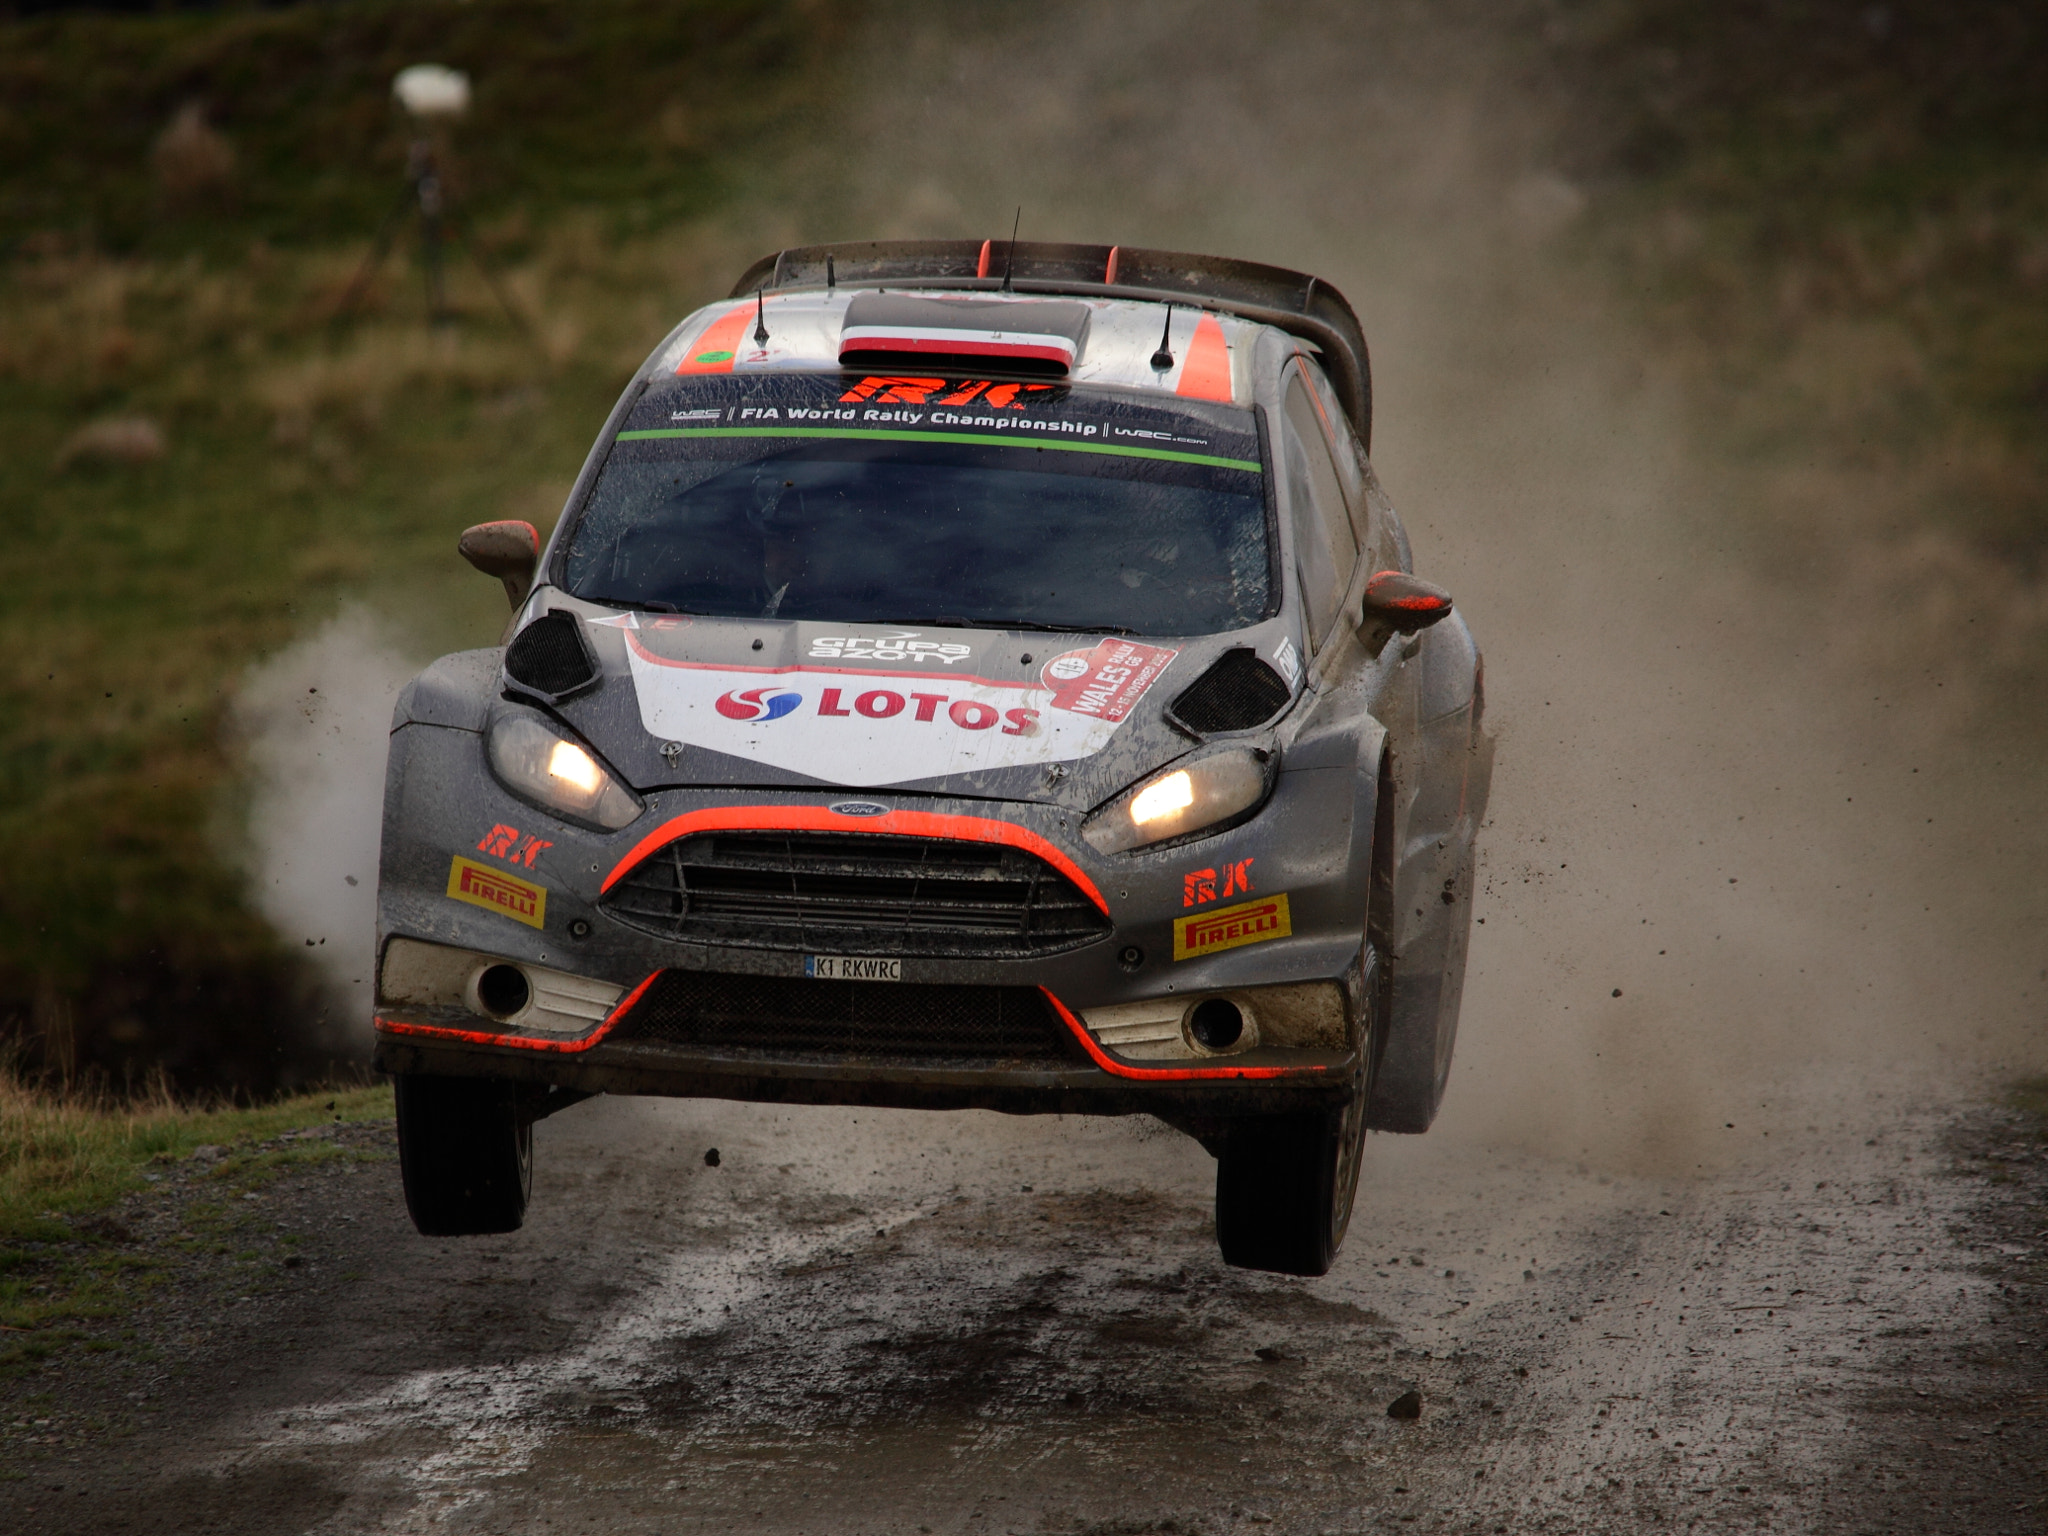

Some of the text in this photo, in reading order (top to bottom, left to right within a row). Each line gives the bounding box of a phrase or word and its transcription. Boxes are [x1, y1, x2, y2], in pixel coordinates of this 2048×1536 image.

[740, 407, 779, 419] FIA
[788, 408, 855, 420] World
[863, 410, 923, 424] Rally
[930, 412, 1097, 436] Championship
[1108, 643, 1135, 664] RALLY
[1124, 655, 1143, 667] GB
[1071, 664, 1131, 713] WALES
[1129, 665, 1157, 700] NOVEMBER
[817, 688, 1041, 736] LOTOS
[841, 804, 877, 814] Ford
[459, 866, 537, 917] PIRELLI
[1185, 903, 1278, 950] PIRELLI
[816, 958, 899, 978] K1 RKWRC
